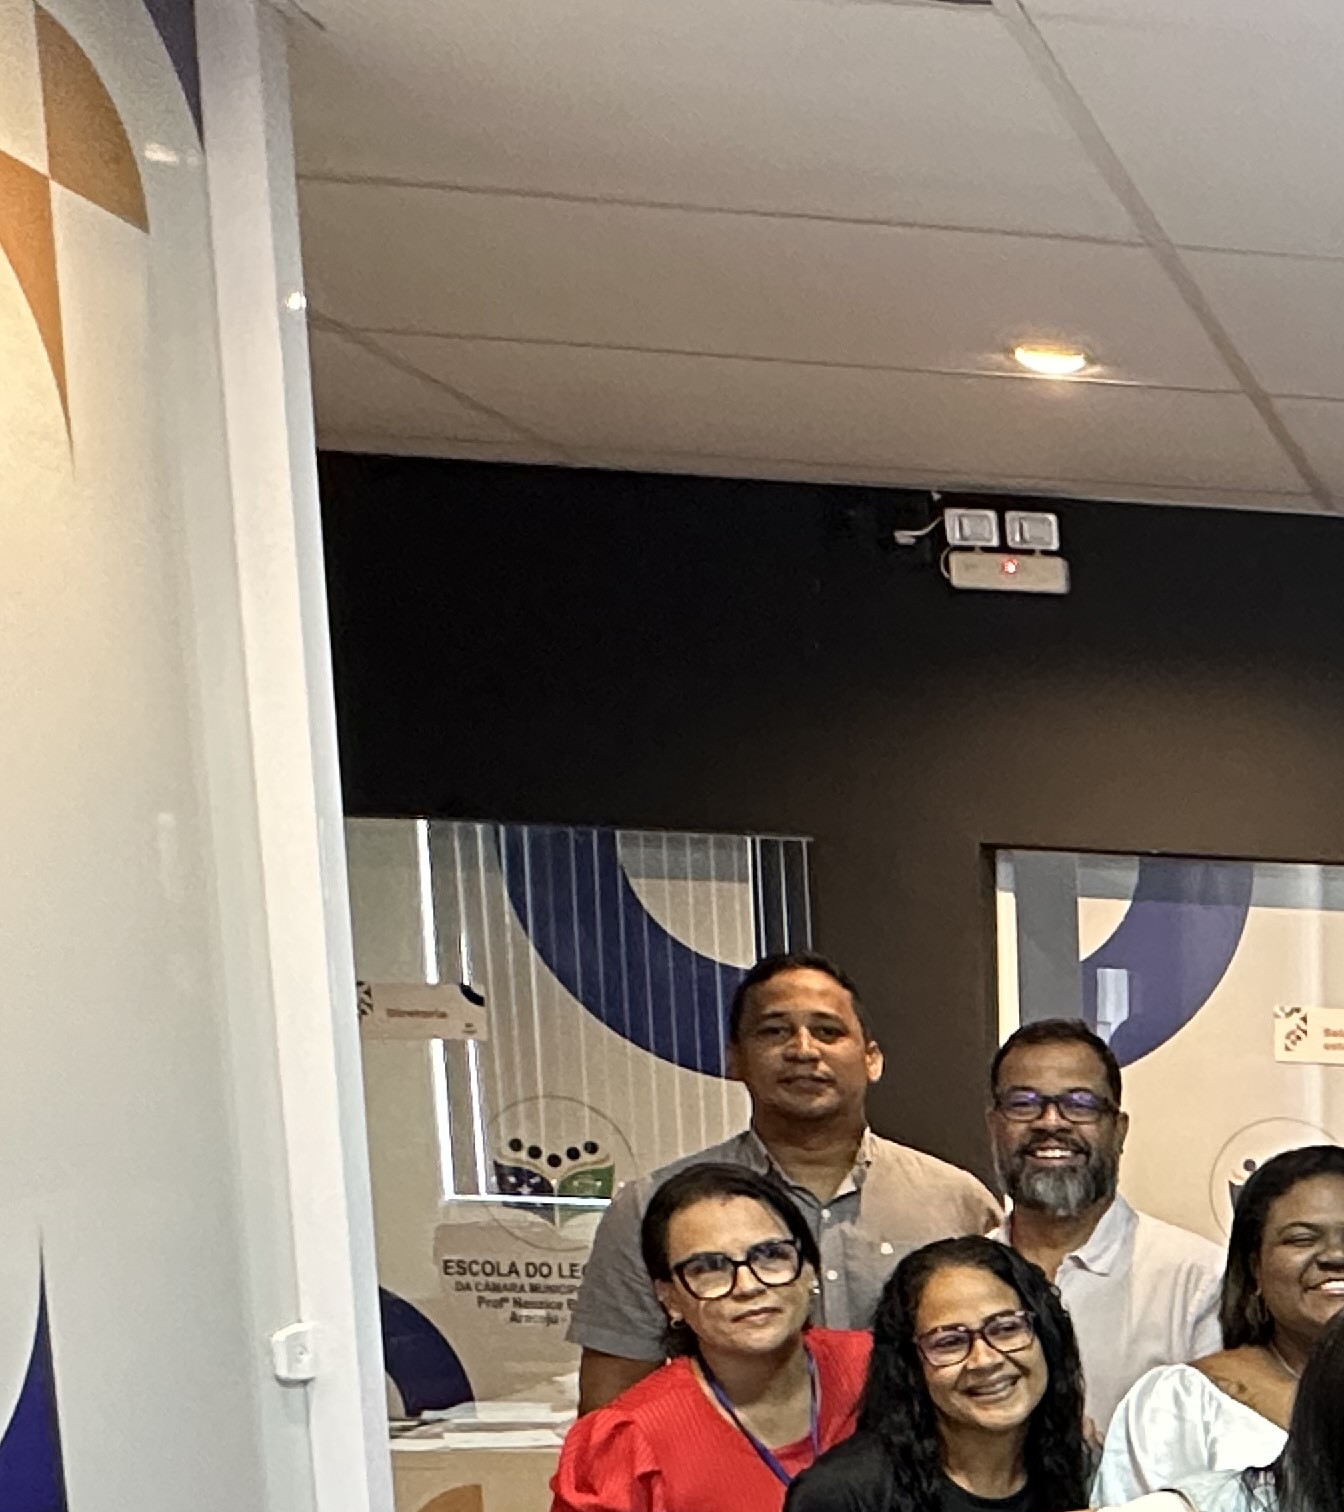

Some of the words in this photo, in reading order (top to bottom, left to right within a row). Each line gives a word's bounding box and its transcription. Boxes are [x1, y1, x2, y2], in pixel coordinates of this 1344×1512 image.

[442, 1259, 520, 1278] ESCOLA
[525, 1261, 552, 1279] DO
[558, 1263, 588, 1280] LE
[454, 1281, 472, 1292] DA
